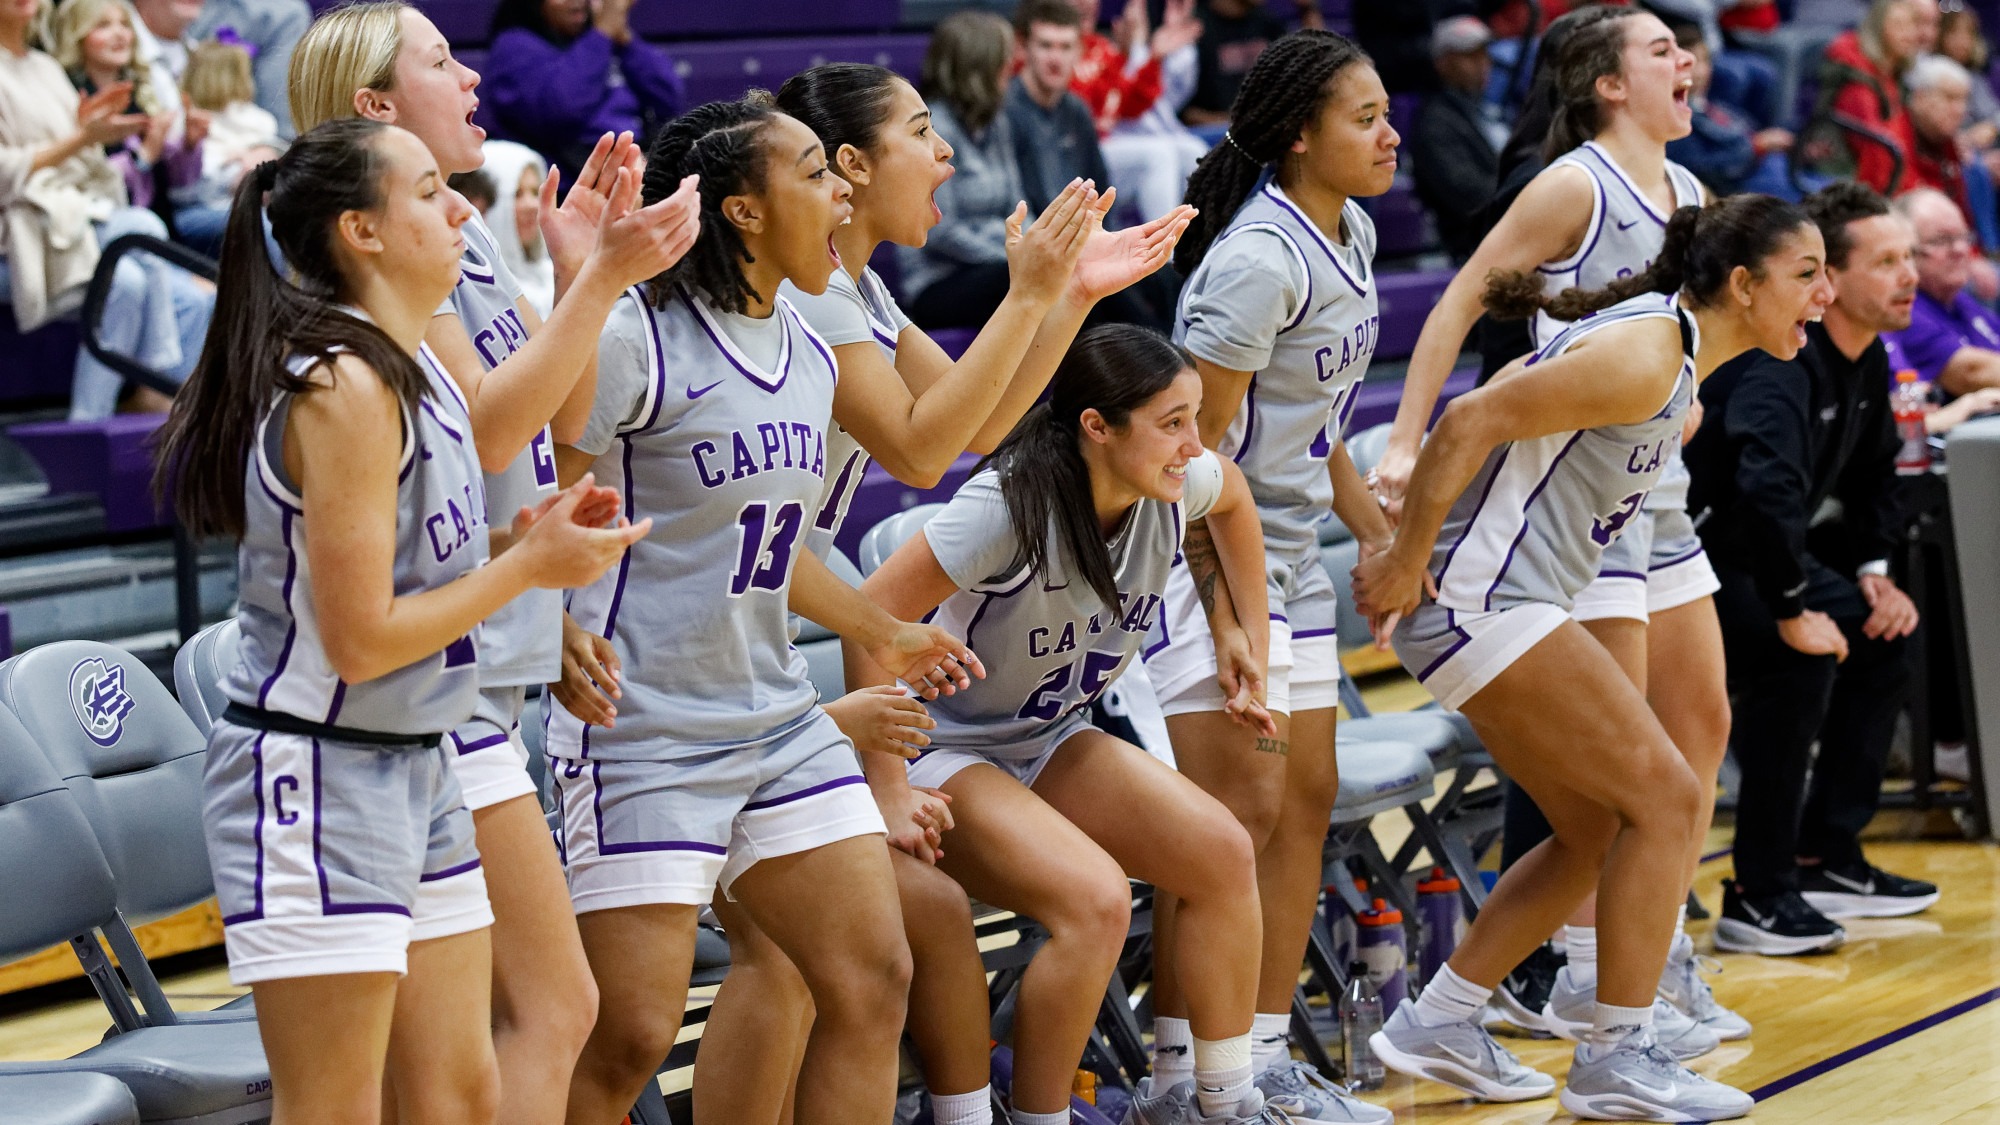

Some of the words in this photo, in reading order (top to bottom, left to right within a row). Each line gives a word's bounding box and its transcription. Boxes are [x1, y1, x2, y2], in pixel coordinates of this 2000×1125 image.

[727, 500, 806, 598] 13
[1027, 591, 1161, 659] CAAL
[1015, 649, 1126, 722] 25
[273, 774, 299, 826] C
